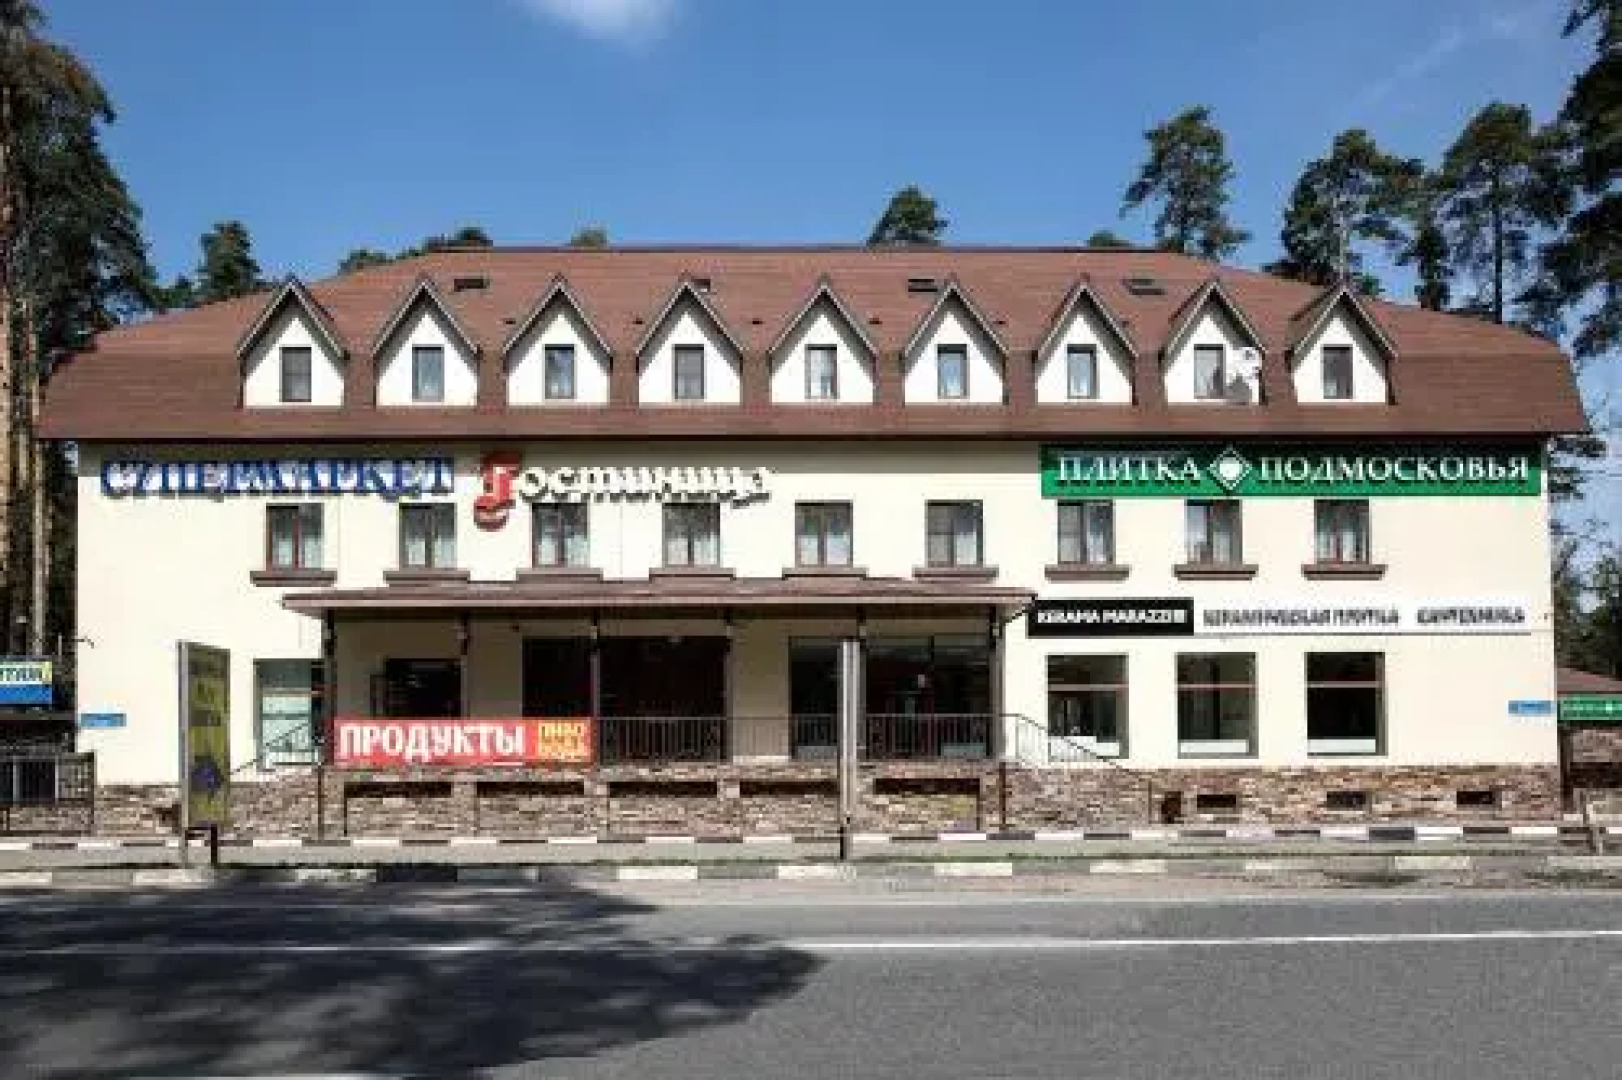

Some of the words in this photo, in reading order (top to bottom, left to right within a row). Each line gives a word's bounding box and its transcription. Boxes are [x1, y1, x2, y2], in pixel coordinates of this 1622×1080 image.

[1057, 454, 1200, 484] ПЛИТКА
[1258, 454, 1530, 484] ПОДМОСКОВЬЯ
[339, 722, 526, 761] ПРОДУКТЫ
